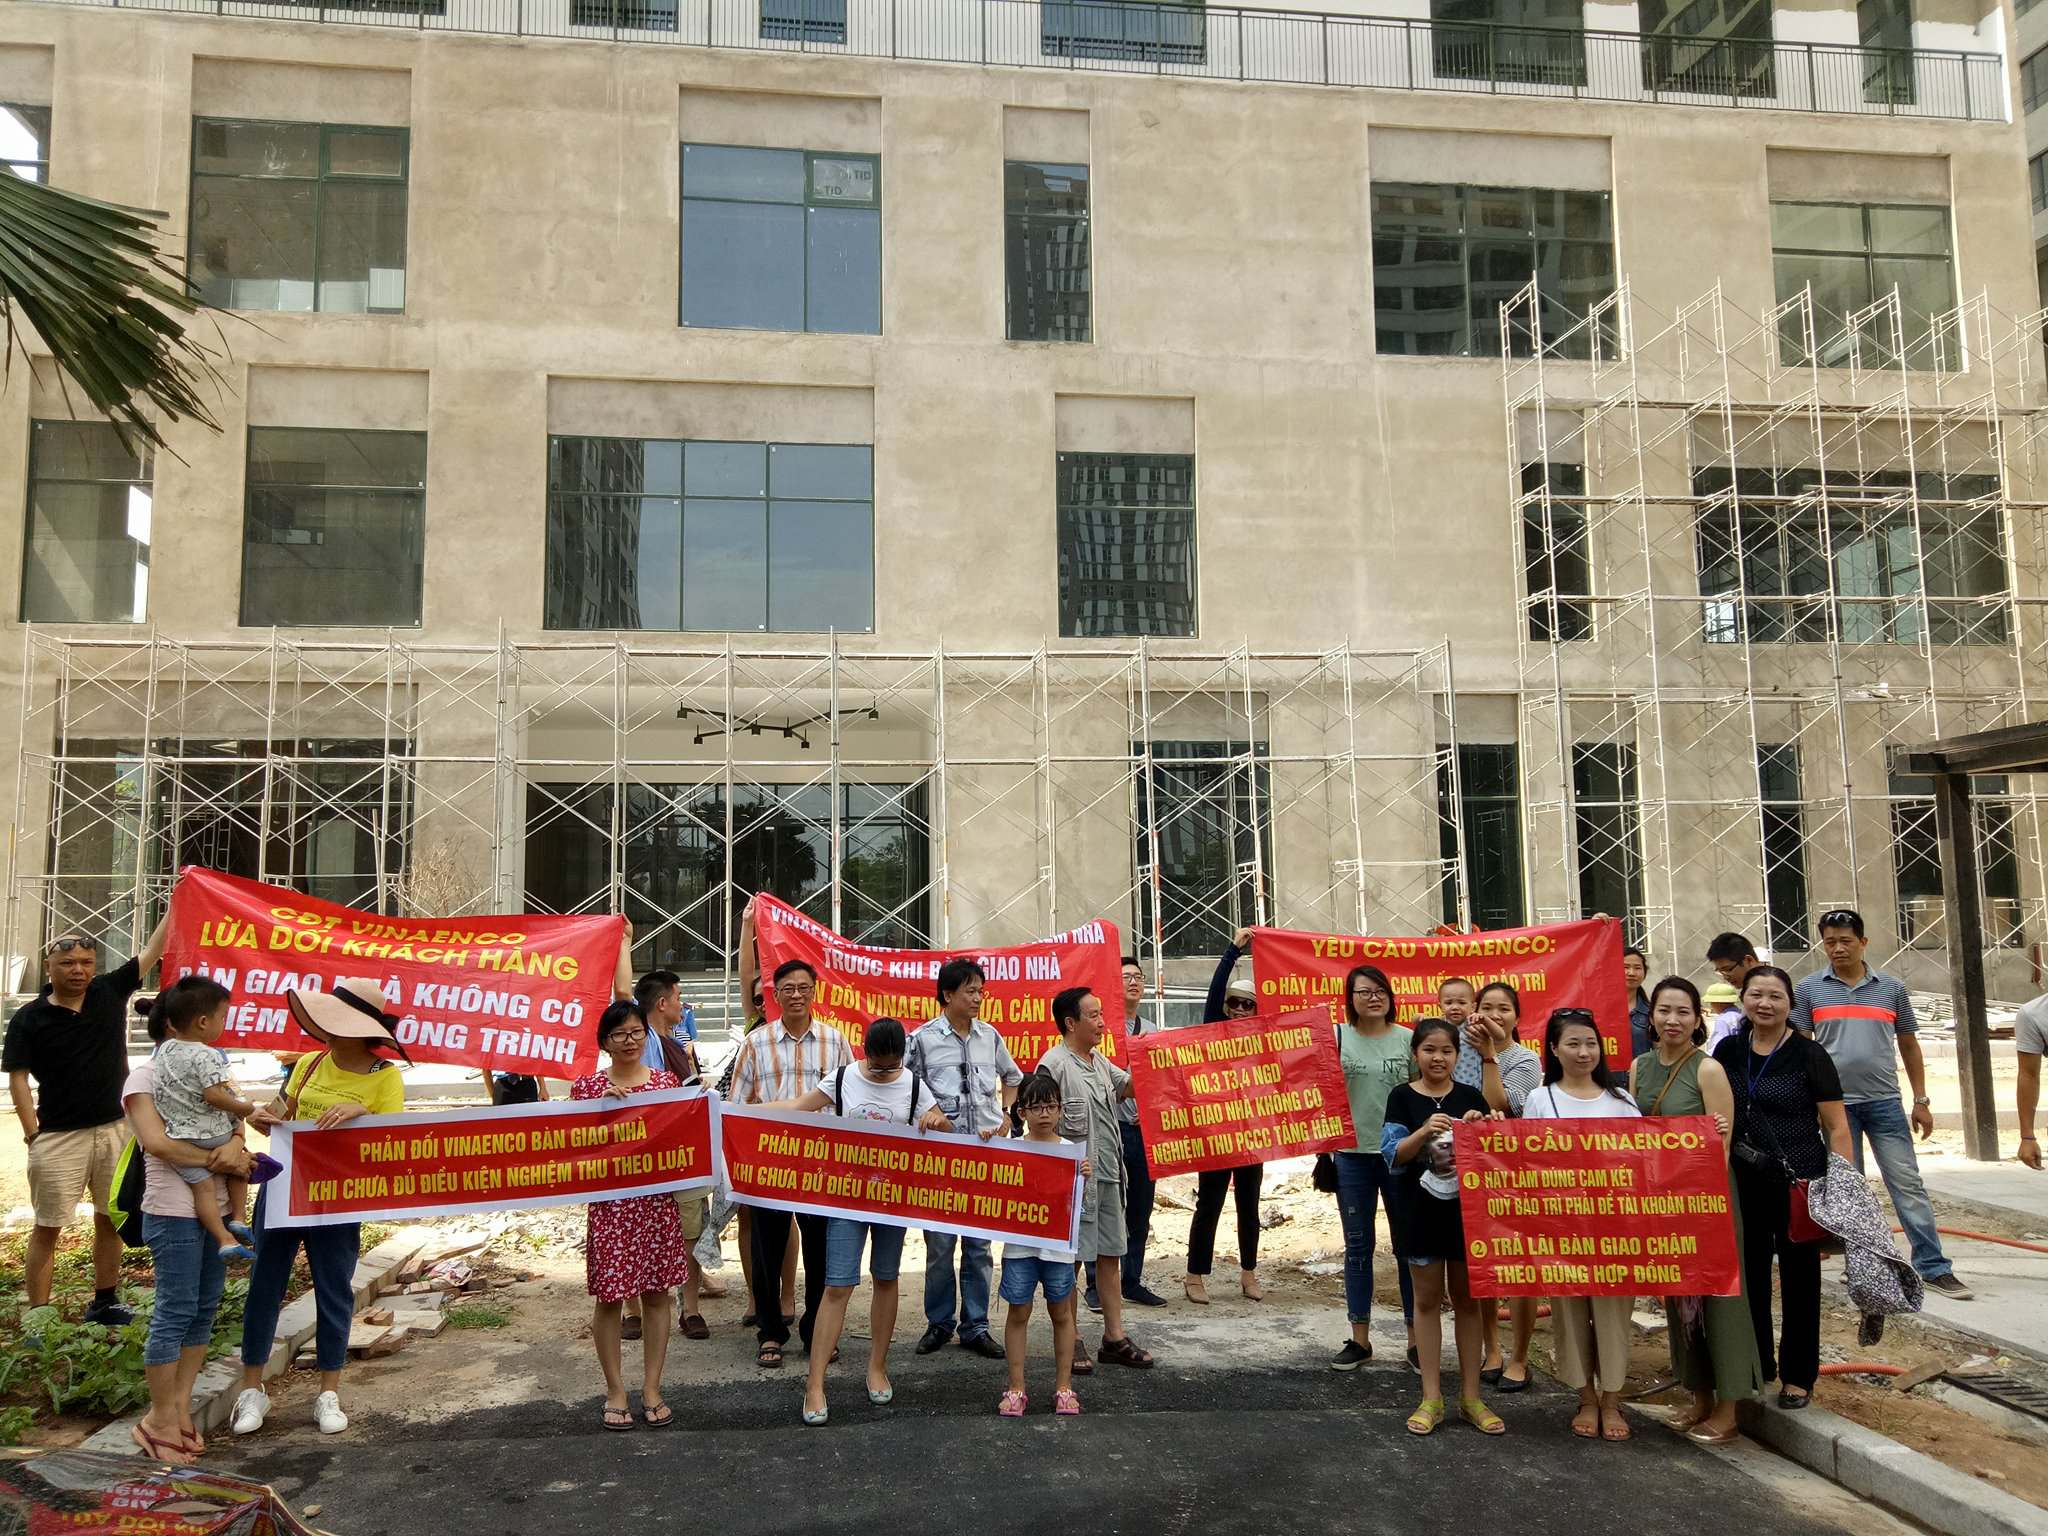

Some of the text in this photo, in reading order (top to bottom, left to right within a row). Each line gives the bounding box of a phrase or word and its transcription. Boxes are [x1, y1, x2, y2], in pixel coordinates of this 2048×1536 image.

[270, 907, 528, 945] CĐT VINAENCO
[200, 915, 258, 951] LỪA
[341, 938, 469, 966] KHÁCH
[478, 947, 579, 981] HÀNG
[1311, 936, 1355, 958] YÊU
[1423, 935, 1557, 959] VINAENCO:
[889, 960, 923, 979] KHI
[1025, 952, 1061, 980] NHÀ
[1279, 973, 1308, 995] HÃY
[1311, 972, 1344, 995] LÀM
[1391, 976, 1424, 994] CAM
[1522, 969, 1547, 991] TRÌ
[245, 969, 323, 996] GIAO
[413, 983, 531, 1020] KHÔNG
[541, 998, 584, 1028] CÓ
[1009, 994, 1045, 1023] CĂN
[395, 1014, 468, 1050] ÔNG
[480, 1027, 577, 1064] TRÌNH
[1148, 1027, 1313, 1070] TÒA NHÀ HORIZON TOWER
[1190, 1072, 1221, 1096] NO.3
[1254, 1062, 1281, 1084] NGD
[1160, 1083, 1324, 1132] BÀN GIAO NHÀ KHÔNG CÓ
[360, 1116, 647, 1162] PHẢN ĐỐI VINAENCO BÀN GIAO NHÀ
[1152, 1134, 1206, 1164] NGHIỆM
[1207, 1131, 1233, 1157] THU
[1236, 1127, 1272, 1151] PCCC
[1479, 1127, 1707, 1153] YÊU CẦU VINAENCO:
[308, 1145, 696, 1202] KHI CHƯA ĐỦ ĐIỀU KIỆN NGHIỆM THU THEO LUẬT
[757, 1129, 1025, 1187] PHẢN ĐỐI VINAENCO BÀN GIAO NHÀ
[1512, 1166, 1538, 1188] LÀM
[1541, 1165, 1576, 1188] ĐÚNG
[1579, 1168, 1608, 1187] CAM
[1611, 1163, 1634, 1187] KẾT
[733, 1161, 1050, 1225] KHI CHƯA ĐỦ ĐIỀU KIỆN NGHIỆM THU PCCC
[1515, 1191, 1540, 1216] BẢO
[1543, 1194, 1562, 1216] TRÌ
[1566, 1191, 1595, 1216] PHẢI
[1599, 1190, 1616, 1215] ĐỂ
[1617, 1193, 1638, 1215] TÀI
[1641, 1190, 1685, 1215] KHOẢN
[1687, 1193, 1728, 1214] RIÊNG
[1491, 1231, 1525, 1256] TRẢ
[1527, 1233, 1555, 1256] LÃI
[1559, 1233, 1596, 1256] BÀN
[1600, 1237, 1641, 1256] GIAO
[1647, 1232, 1697, 1259] CHẬM
[1494, 1258, 1682, 1288] THEO ĐÚNG HỢP ĐỒNG
